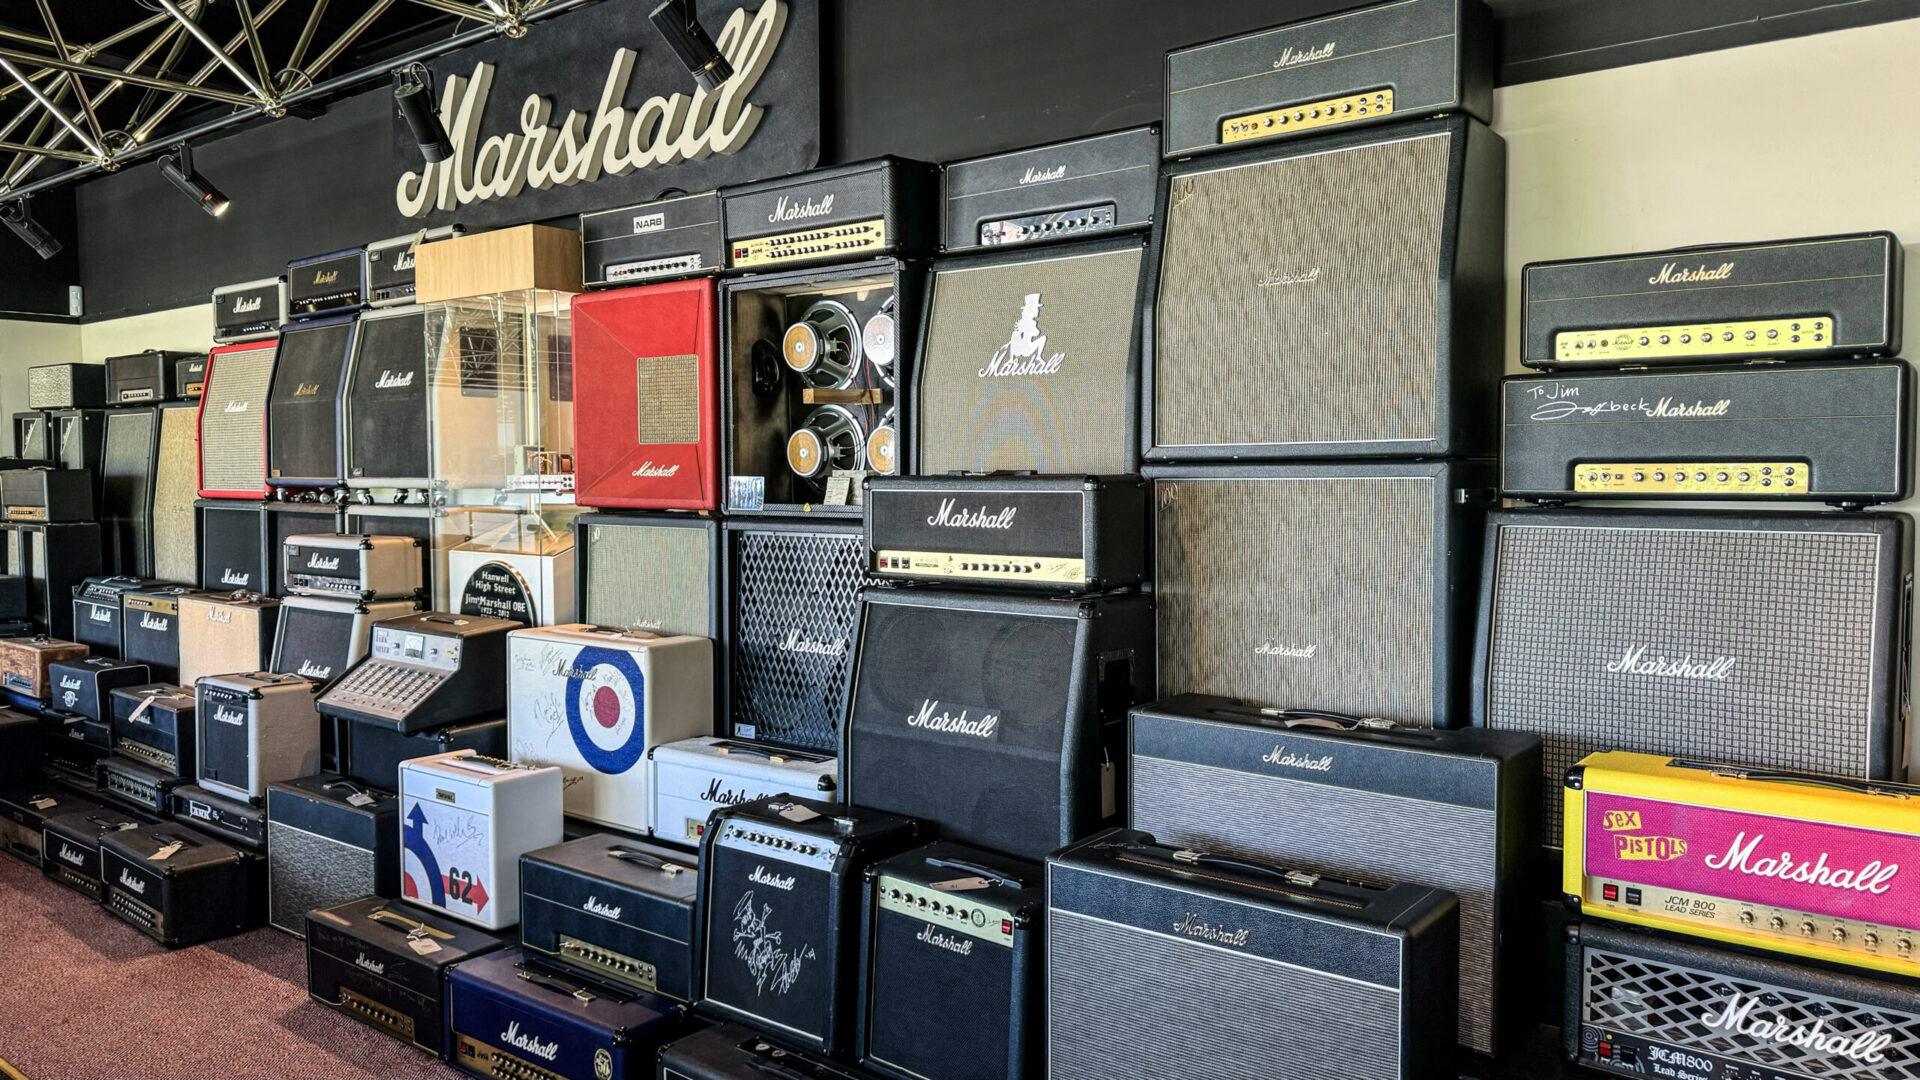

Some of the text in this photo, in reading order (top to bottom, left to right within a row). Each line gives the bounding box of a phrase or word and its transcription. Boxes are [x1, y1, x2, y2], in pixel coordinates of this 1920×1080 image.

[1273, 42, 1336, 68] Marshall
[397, 0, 787, 218] Marshall
[1019, 165, 1067, 185] Marshall
[768, 193, 835, 223] Marshall
[636, 218, 662, 230] NARB
[393, 251, 416, 272] Mars
[313, 270, 340, 285] Marshall
[1648, 262, 1735, 285] Marshall
[233, 297, 262, 314] Marshall
[978, 350, 1066, 378] Marshall
[375, 369, 414, 388] Marshall
[1546, 383, 1580, 399] Jim
[1646, 396, 1731, 417] Marshall
[632, 460, 680, 477] Marshall
[927, 497, 1018, 530] Marshall
[307, 552, 340, 570] Marshall
[221, 568, 249, 586] Marshall
[475, 580, 516, 595] High Street
[482, 571, 510, 583] Hanwell
[480, 596, 512, 611] Marshall
[512, 602, 526, 613] OBE
[140, 612, 168, 631] Marshall
[779, 628, 847, 657] Marshall
[1255, 637, 1318, 659] Marshall
[298, 659, 332, 679] Marshall
[553, 658, 599, 681] Marshall
[1606, 644, 1737, 679] Marshall
[213, 704, 244, 726] Marshall
[907, 698, 999, 738] Marshall
[1262, 744, 1334, 772] Marshall
[700, 777, 769, 805] Marsh
[1704, 831, 1899, 894] Marshall
[119, 867, 146, 894] Marshall
[449, 866, 473, 906] 62
[749, 864, 796, 891] Marshall
[583, 895, 623, 920] Marshall
[1664, 895, 1716, 911] JCM 800
[1664, 904, 1716, 919] LEAD SERIES
[916, 923, 974, 956] Marshall
[1173, 911, 1250, 947] Marshall
[1701, 991, 1893, 1064] Marshall
[501, 1020, 559, 1062] Marshall
[1648, 1045, 1713, 1072] JCM800
[1653, 1063, 1676, 1077] Lead
